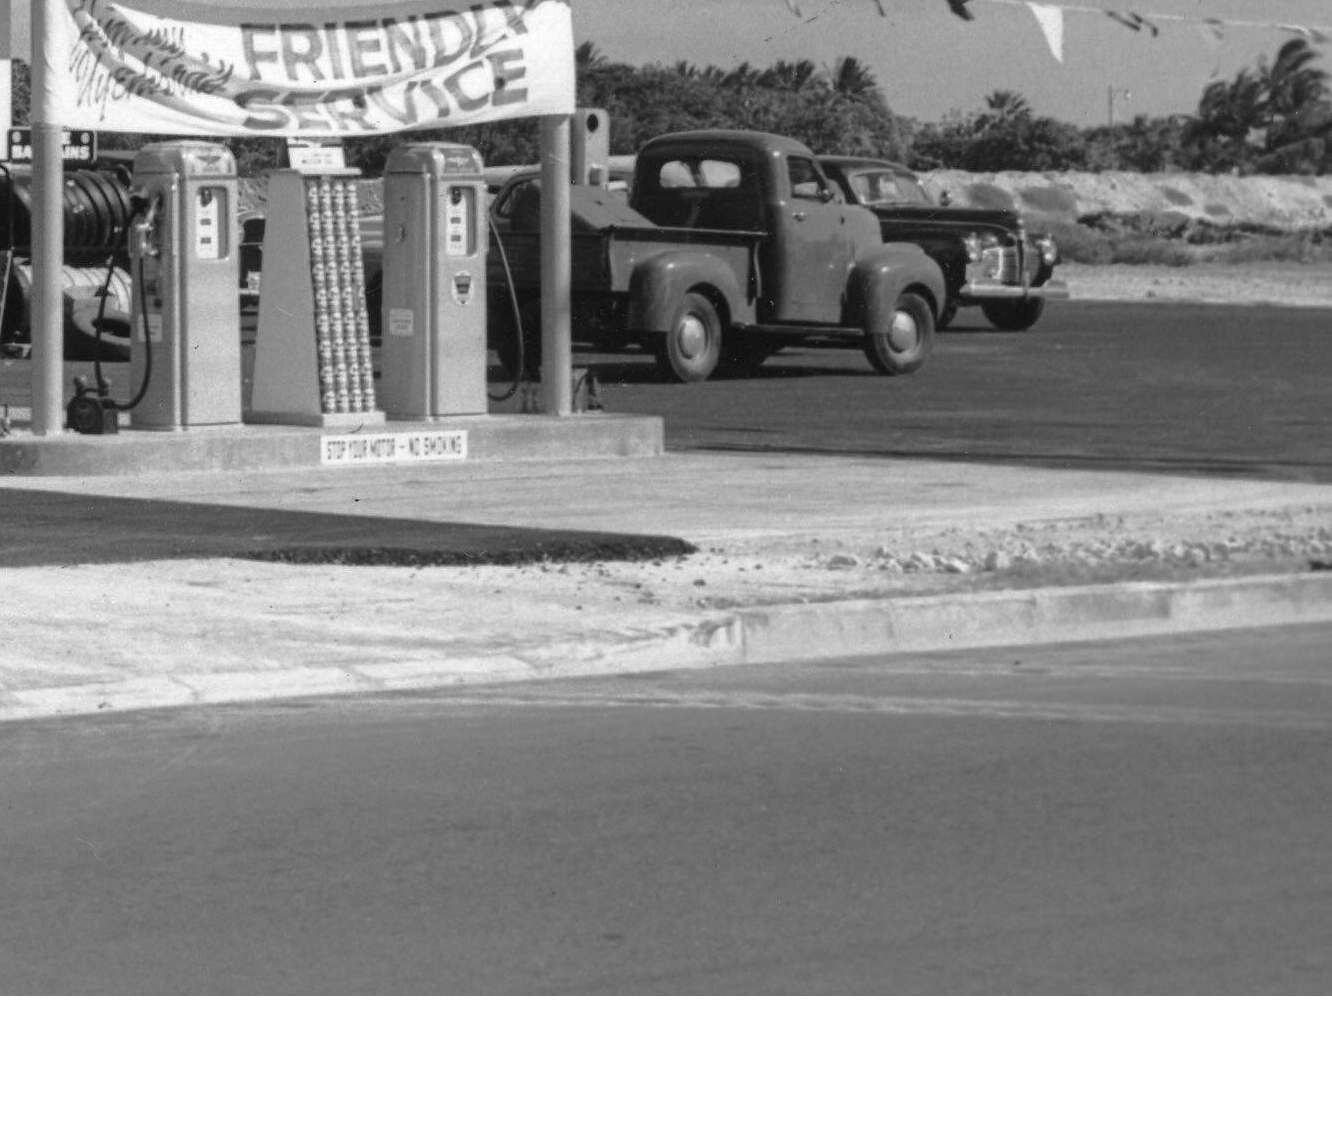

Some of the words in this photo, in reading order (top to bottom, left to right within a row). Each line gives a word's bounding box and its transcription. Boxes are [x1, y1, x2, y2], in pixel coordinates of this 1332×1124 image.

[235, 48, 529, 131] SERVICE
[11, 145, 91, 160] BAINS
[327, 440, 346, 460] STOP
[348, 439, 368, 459] YOUR
[370, 437, 395, 458] MOTOR
[409, 436, 420, 456] NO
[424, 435, 462, 456] SMOKING
